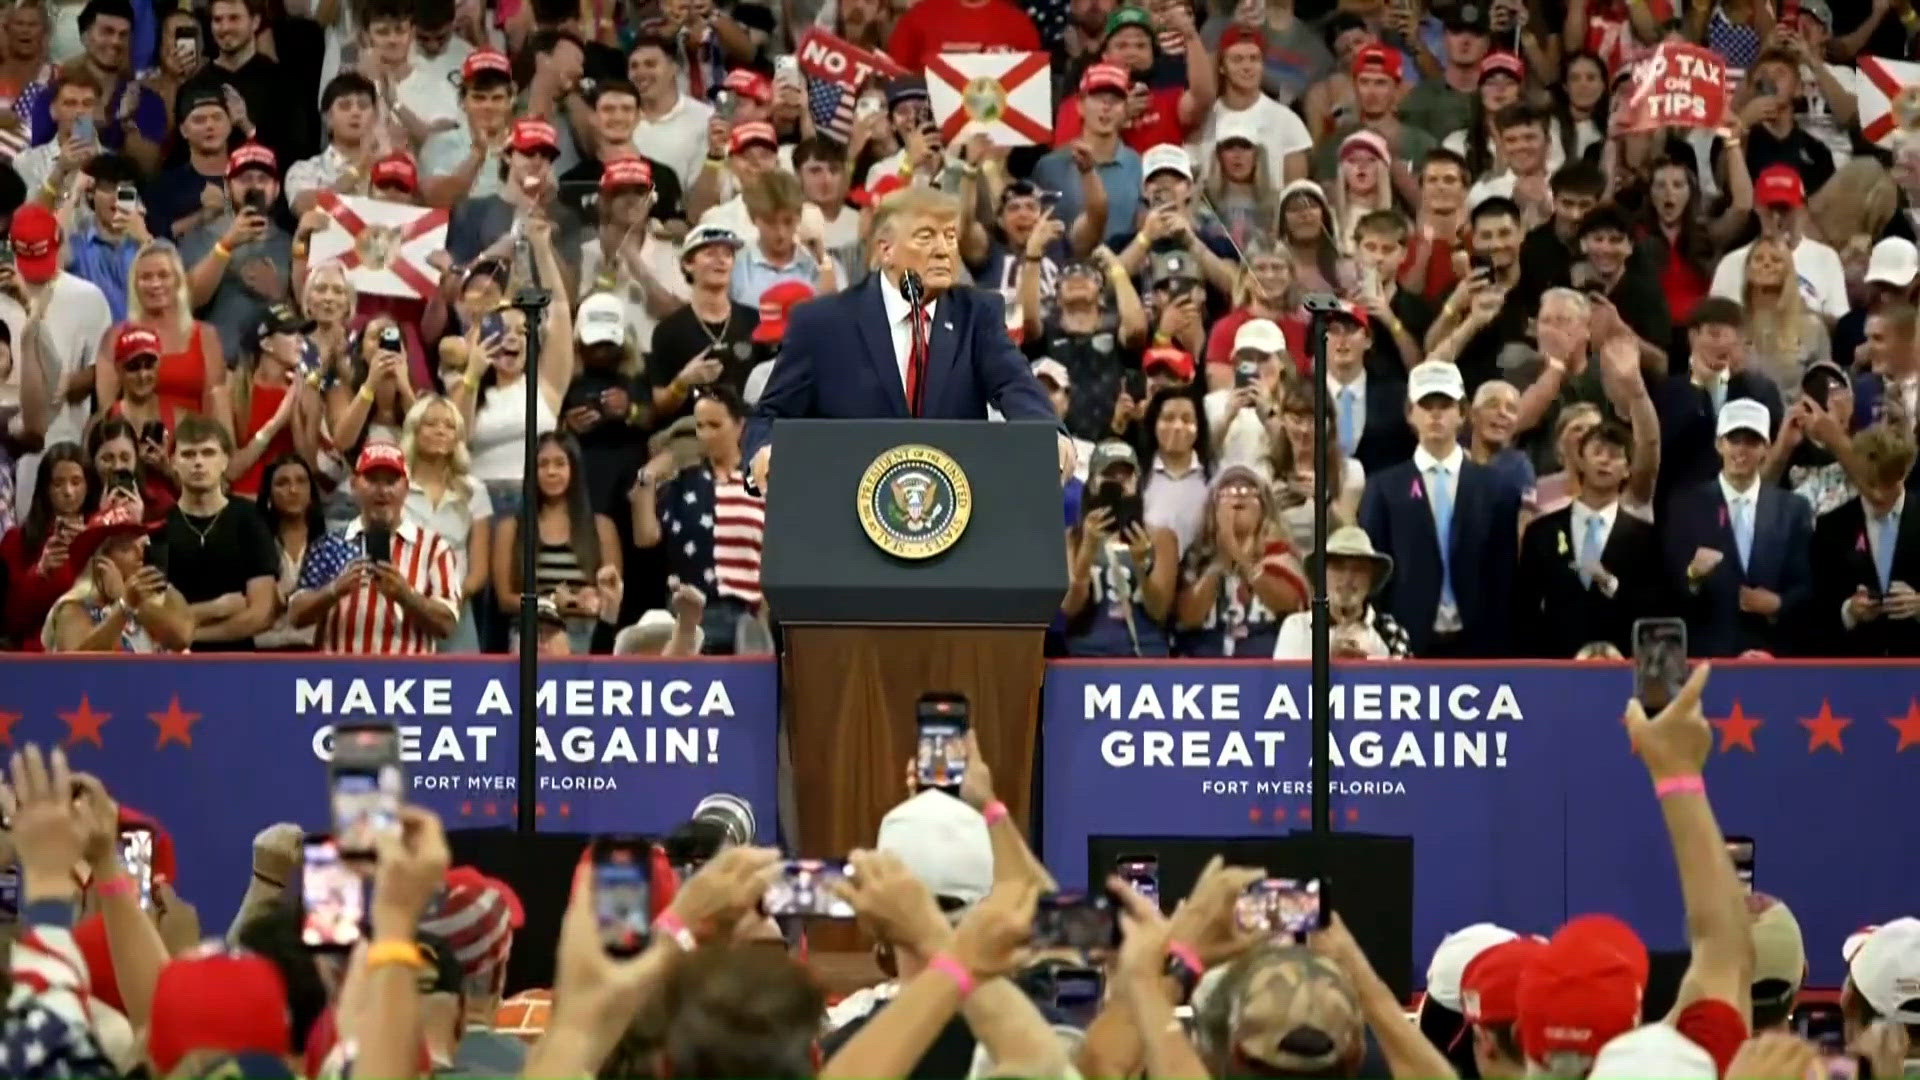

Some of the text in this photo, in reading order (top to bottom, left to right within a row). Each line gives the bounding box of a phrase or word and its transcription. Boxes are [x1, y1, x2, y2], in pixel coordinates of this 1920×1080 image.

[801, 39, 847, 75] NO
[1675, 52, 1720, 87] TAX
[1664, 77, 1692, 93] ON
[1648, 93, 1706, 119] TIPS
[861, 450, 910, 499] PRESIDENT
[295, 678, 736, 717] MAKE AMERICA
[1083, 683, 1524, 721] MAKE AMERICA
[311, 725, 720, 765] GEAT AGAIN!
[1100, 730, 1286, 768] GREAT
[413, 775, 461, 790] FORT
[539, 775, 617, 790] FLORIDA
[1202, 780, 1250, 795] FORT
[1328, 780, 1406, 795] FLORIDA
